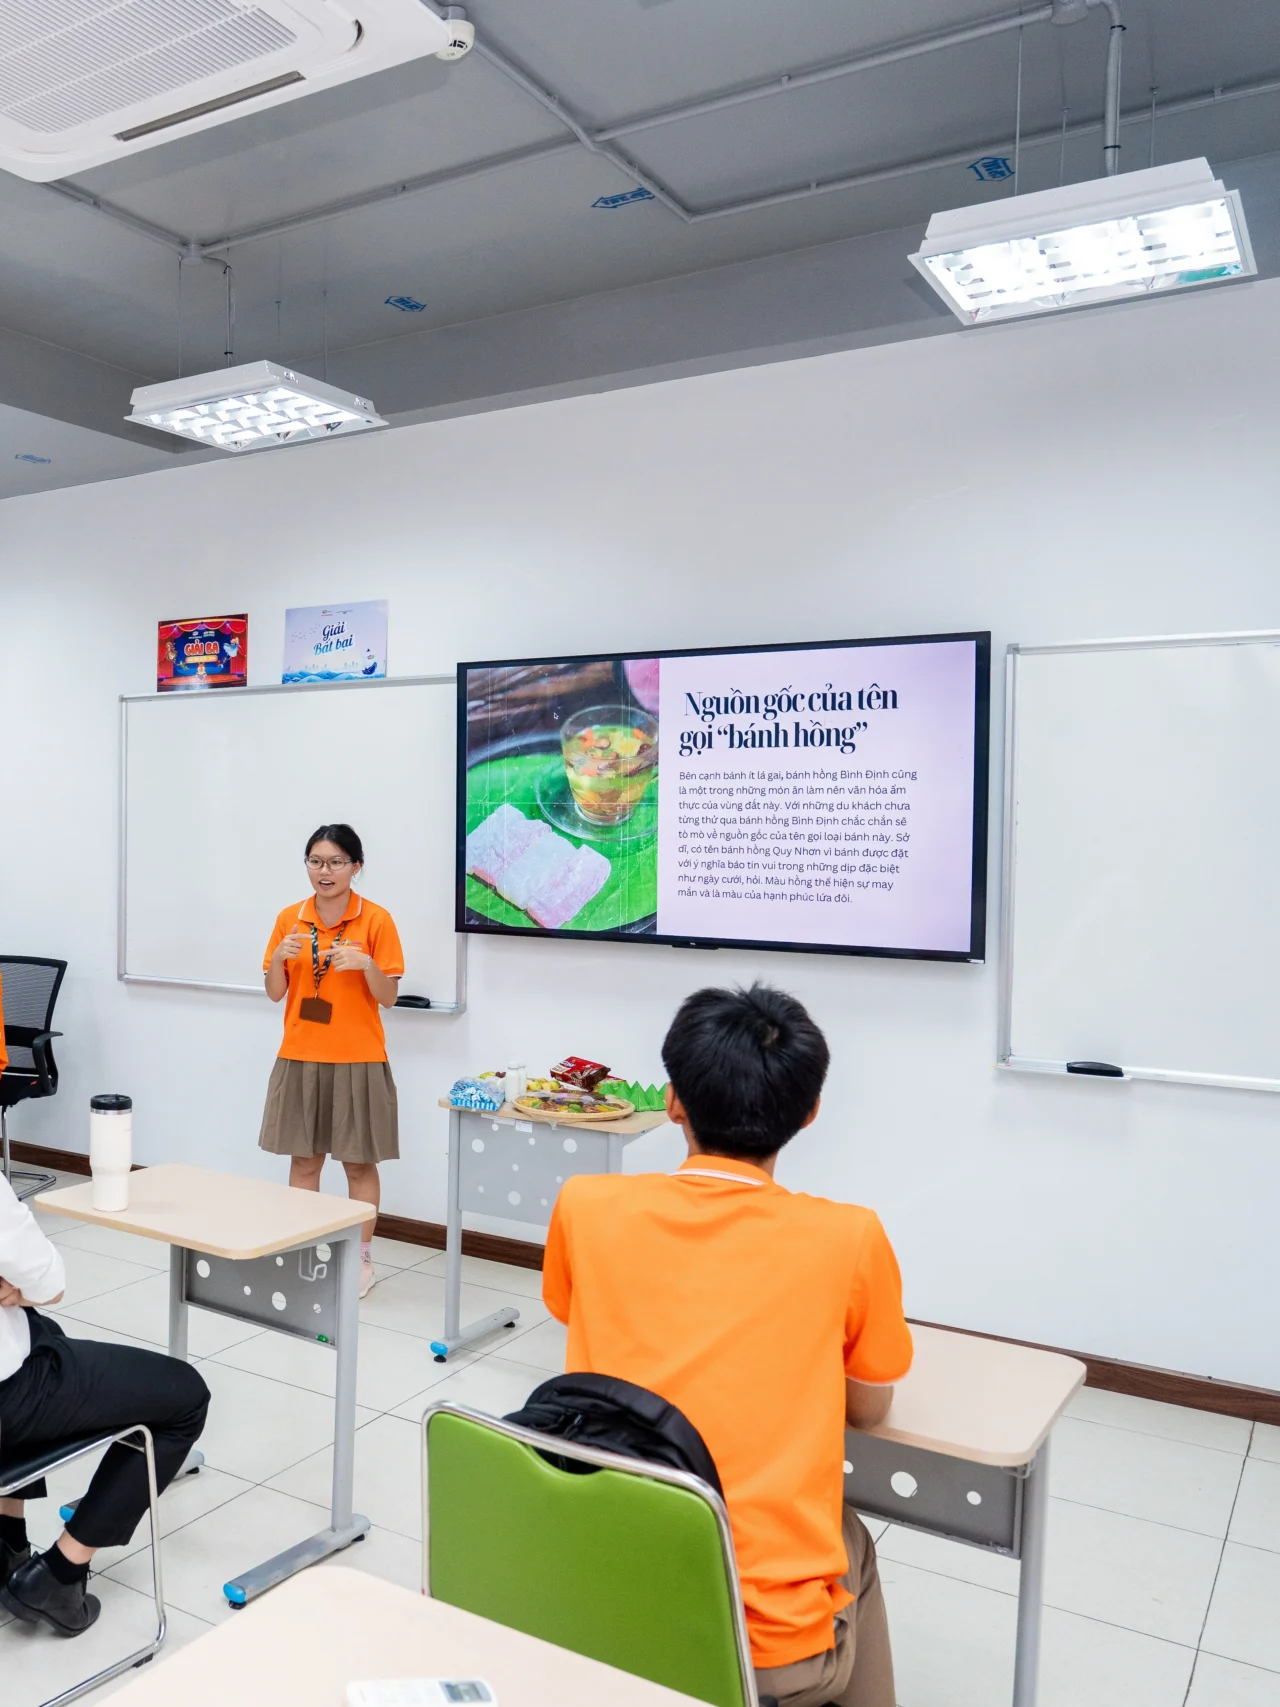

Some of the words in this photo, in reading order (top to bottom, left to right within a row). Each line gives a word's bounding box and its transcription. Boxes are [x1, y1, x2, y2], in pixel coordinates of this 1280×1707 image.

[323, 622, 345, 641] Giải
[205, 641, 219, 654] BA
[314, 638, 333, 655] Bất
[336, 635, 353, 651] bại
[684, 688, 760, 722] Nguồn
[763, 685, 805, 720] gốc
[808, 683, 853, 712] của
[858, 683, 898, 710] tên
[679, 724, 714, 757] gọi
[717, 722, 789, 749] “bánh
[793, 720, 868, 754] hồng”
[680, 772, 696, 780] Bên
[699, 772, 720, 781] cạnh
[724, 772, 746, 780] bánh
[758, 771, 765, 779] lá
[768, 772, 784, 781] gai,
[786, 771, 810, 779] bánh
[813, 768, 837, 781] hồng
[841, 771, 862, 779] Bình
[865, 770, 889, 780] Định
[892, 770, 917, 780] cũng
[679, 786, 686, 794] là
[689, 786, 707, 796] một
[709, 787, 734, 796] trong
[736, 786, 766, 796] những
[792, 786, 803, 794] ăn
[807, 786, 824, 794] làm
[827, 786, 845, 794] nên
[848, 786, 866, 794] văn
[869, 786, 888, 794] hóa
[679, 801, 700, 810] thực
[702, 801, 718, 809] của
[720, 802, 742, 811] vùng
[745, 799, 760, 809] đất
[763, 802, 782, 811] này.
[785, 801, 800, 809] Với
[803, 801, 834, 812] những
[836, 802, 849, 810] du
[852, 802, 881, 810] khách
[885, 802, 910, 810] chưa
[679, 816, 699, 826] từng
[702, 816, 718, 824] thử
[720, 817, 736, 826] qua
[740, 816, 762, 824] bánh
[766, 814, 789, 827] hồng
[792, 817, 813, 825] Bình
[816, 817, 839, 826] Định
[841, 815, 865, 825] chắc
[868, 815, 892, 826] chắn
[895, 818, 907, 826] sẽ
[707, 829, 717, 839] về
[720, 829, 748, 841] nguồn
[751, 829, 767, 841] gốc
[770, 831, 787, 840] của
[790, 832, 805, 840] tên
[808, 832, 821, 842] gọi
[825, 832, 841, 842] loại
[845, 832, 869, 841] bánh
[872, 834, 893, 844] này.
[896, 832, 910, 842] Sở
[678, 845, 688, 854] dĩ,
[691, 845, 702, 853] có
[704, 845, 718, 853] tên
[722, 846, 744, 854] bánh
[747, 844, 770, 856] hồng
[773, 846, 792, 857] Quy
[795, 847, 820, 855] Nhơn
[824, 848, 831, 856] vì
[835, 848, 859, 856] bánh
[862, 848, 888, 858] được
[678, 859, 691, 867] với
[694, 860, 698, 869] ý
[701, 860, 725, 870] nghĩa
[728, 860, 745, 868] báo
[748, 861, 759, 869] tin
[778, 862, 804, 872] trong
[807, 863, 838, 873] những
[841, 864, 856, 873] dịp
[859, 864, 877, 874] đặc
[880, 864, 900, 874] biệt
[698, 876, 719, 885] ngày
[722, 876, 744, 885] cưới,
[746, 875, 762, 884] hỏi.
[765, 877, 785, 885] Màu
[788, 875, 812, 888] hồng
[815, 877, 831, 886] thể
[834, 878, 854, 889] hiện
[857, 881, 869, 889] sự
[872, 881, 893, 891] may
[745, 890, 761, 899] của
[764, 892, 787, 901] hạnh
[790, 892, 814, 902] phúc
[817, 893, 832, 902] lứa
[834, 894, 852, 902] đôi.
